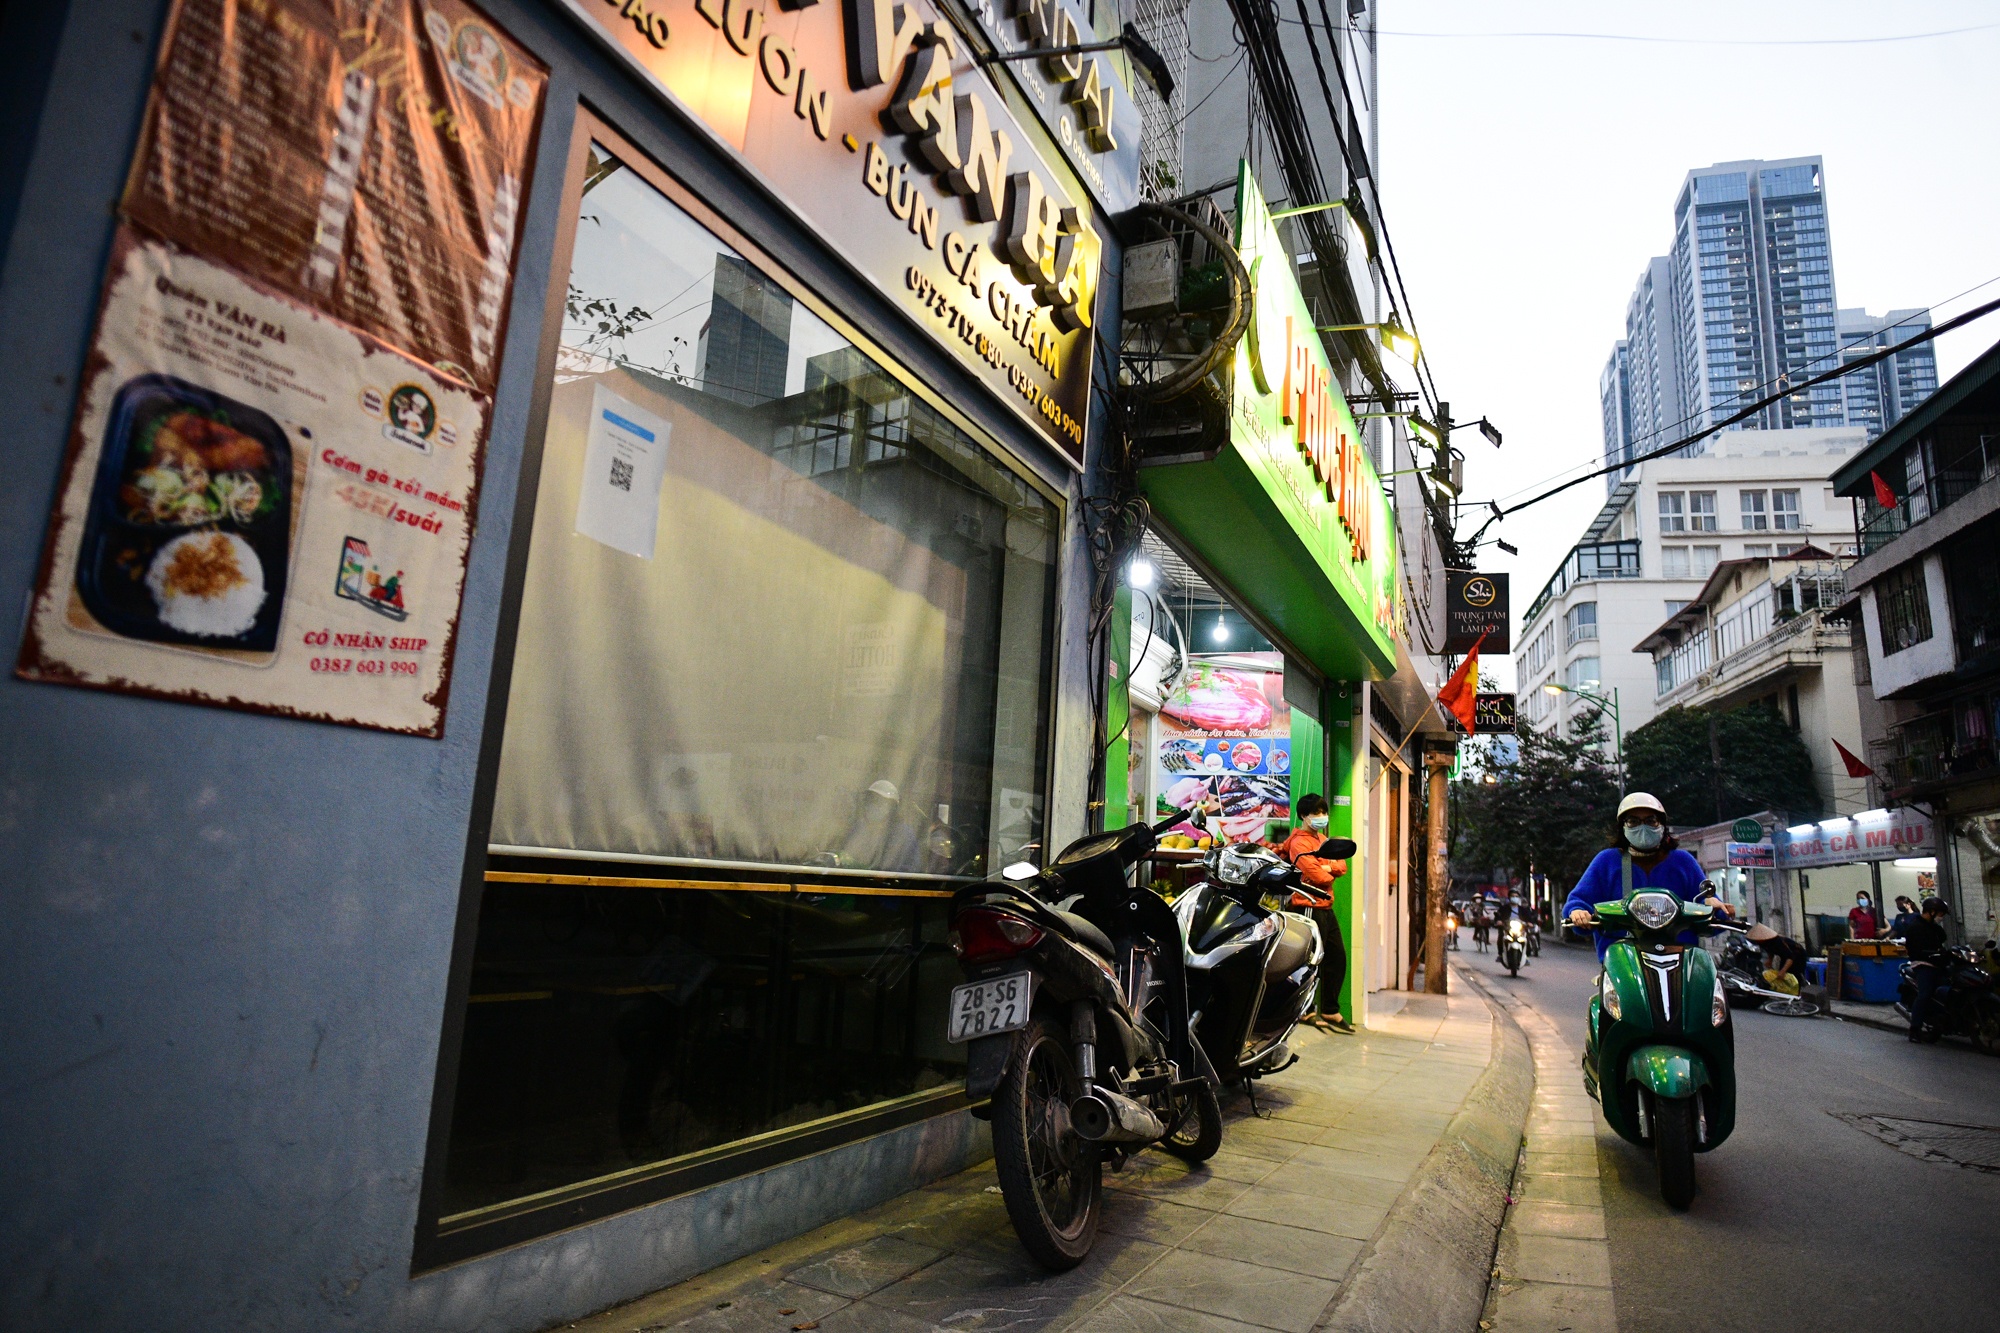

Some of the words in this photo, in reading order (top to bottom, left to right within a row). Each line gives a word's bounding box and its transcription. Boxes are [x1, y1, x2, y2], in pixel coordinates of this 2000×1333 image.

[1021, 59, 1046, 104] Bridal
[852, 0, 1013, 222] VÂN
[1010, 170, 1092, 330] HÀ
[863, 142, 939, 250] BÚN
[943, 231, 982, 298] CÁ
[1008, 364, 1041, 405] 0387
[1039, 394, 1062, 426] 603
[1063, 414, 1082, 444] 990
[321, 448, 362, 475] Cơm
[364, 467, 391, 483] gà
[1466, 581, 1492, 598] Shi
[1486, 610, 1506, 620] TÂM
[303, 628, 329, 646] CÓ
[333, 630, 385, 652] NHẬN
[388, 636, 429, 651] SHIP
[309, 658, 352, 672] 0387
[356, 660, 384, 674] 603
[390, 661, 418, 675] 990
[1789, 838, 1825, 858] CUA
[1829, 831, 1859, 853] CÀ
[1865, 824, 1924, 849] MAU
[962, 980, 1017, 1012] 28-S6
[961, 1003, 1016, 1037] 7822
